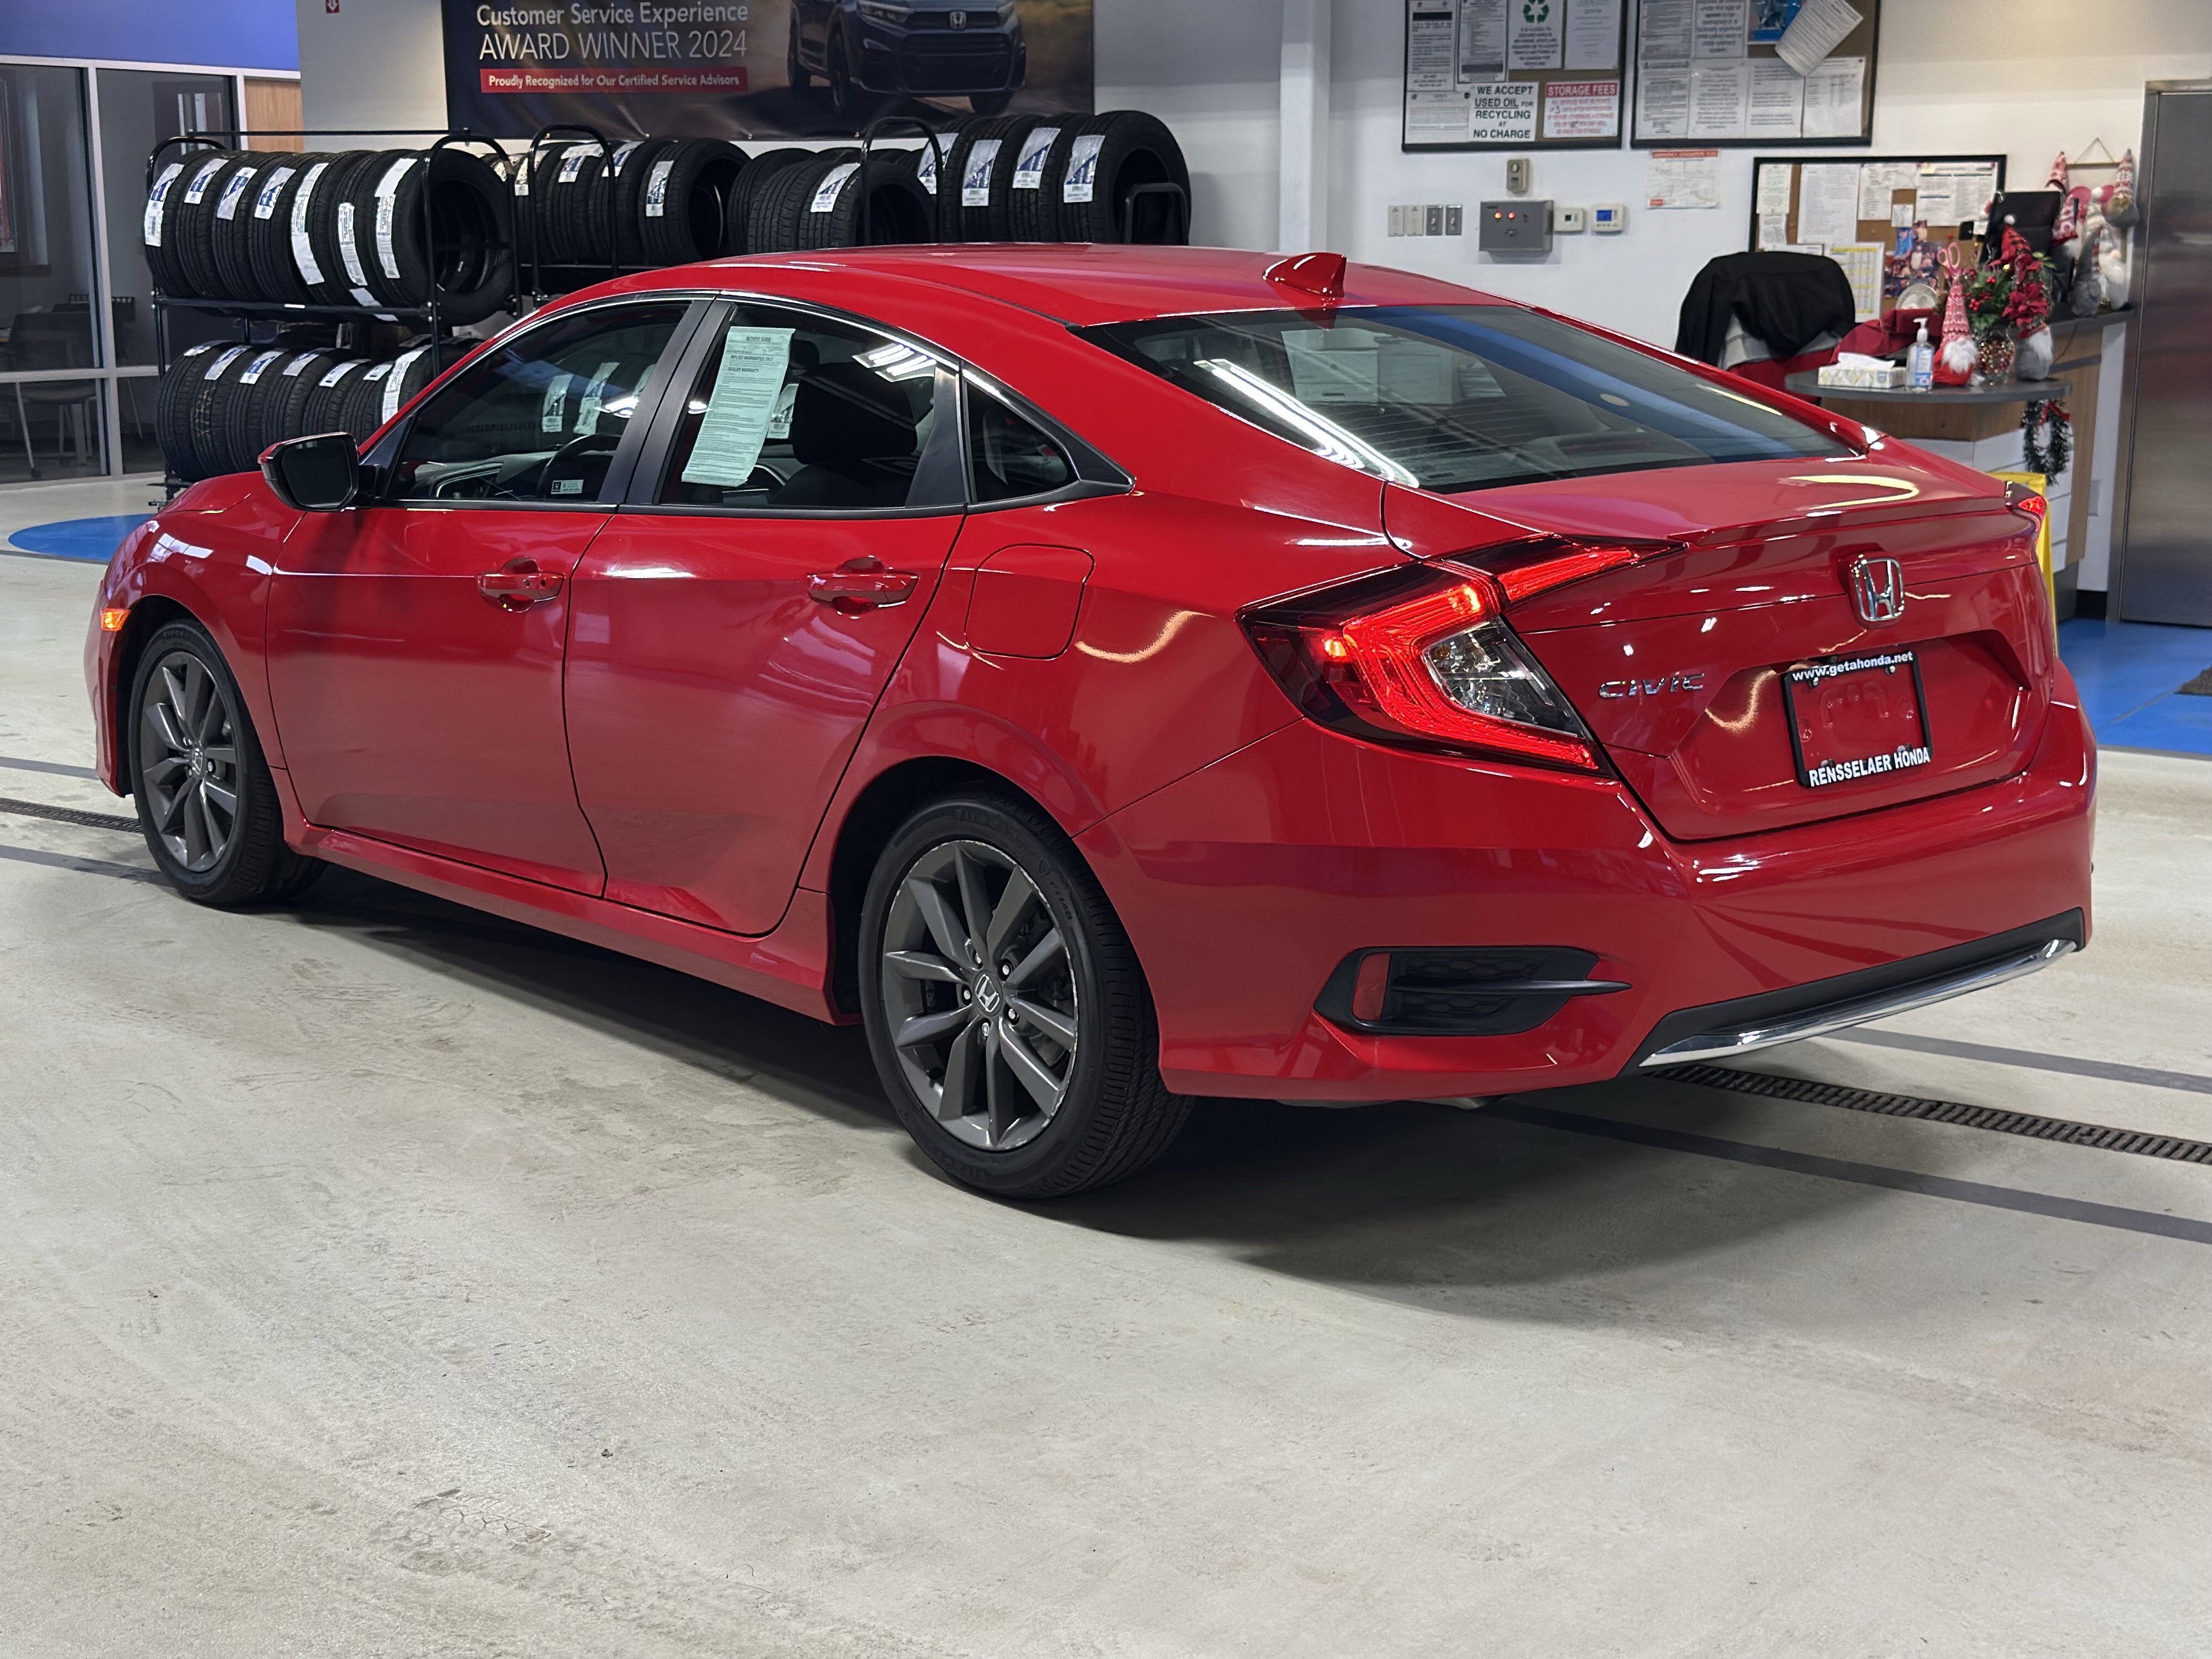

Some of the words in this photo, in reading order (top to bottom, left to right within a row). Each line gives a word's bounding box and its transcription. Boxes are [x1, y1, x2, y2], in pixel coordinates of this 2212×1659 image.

[477, 4, 565, 26] Customer
[571, 2, 634, 24] Service
[640, 1, 748, 29] Experience
[479, 32, 569, 60] AWARD
[578, 32, 681, 59] WINNER
[689, 30, 747, 58] 2024
[489, 75, 523, 89] Proudly
[525, 75, 579, 88] Recognized
[581, 75, 594, 86] for
[596, 75, 616, 86] Our
[618, 74, 658, 86] Certified
[661, 74, 697, 85] Service
[700, 74, 740, 85] Advisors
[1477, 86, 1492, 94] WE
[1494, 86, 1533, 94] ACCEPT
[1548, 85, 1590, 96] STORAGE
[1592, 84, 1616, 95] FEES
[1475, 98, 1501, 107] USED
[1503, 98, 1519, 107] OIL
[1476, 110, 1531, 119] RECYCLING
[1474, 129, 1487, 138] NO
[1490, 129, 1531, 138] CHARGE
[1792, 651, 1914, 681] www.getahonda.net
[1809, 754, 1892, 787] RENSSELAER
[1893, 747, 1931, 769] HONDA
